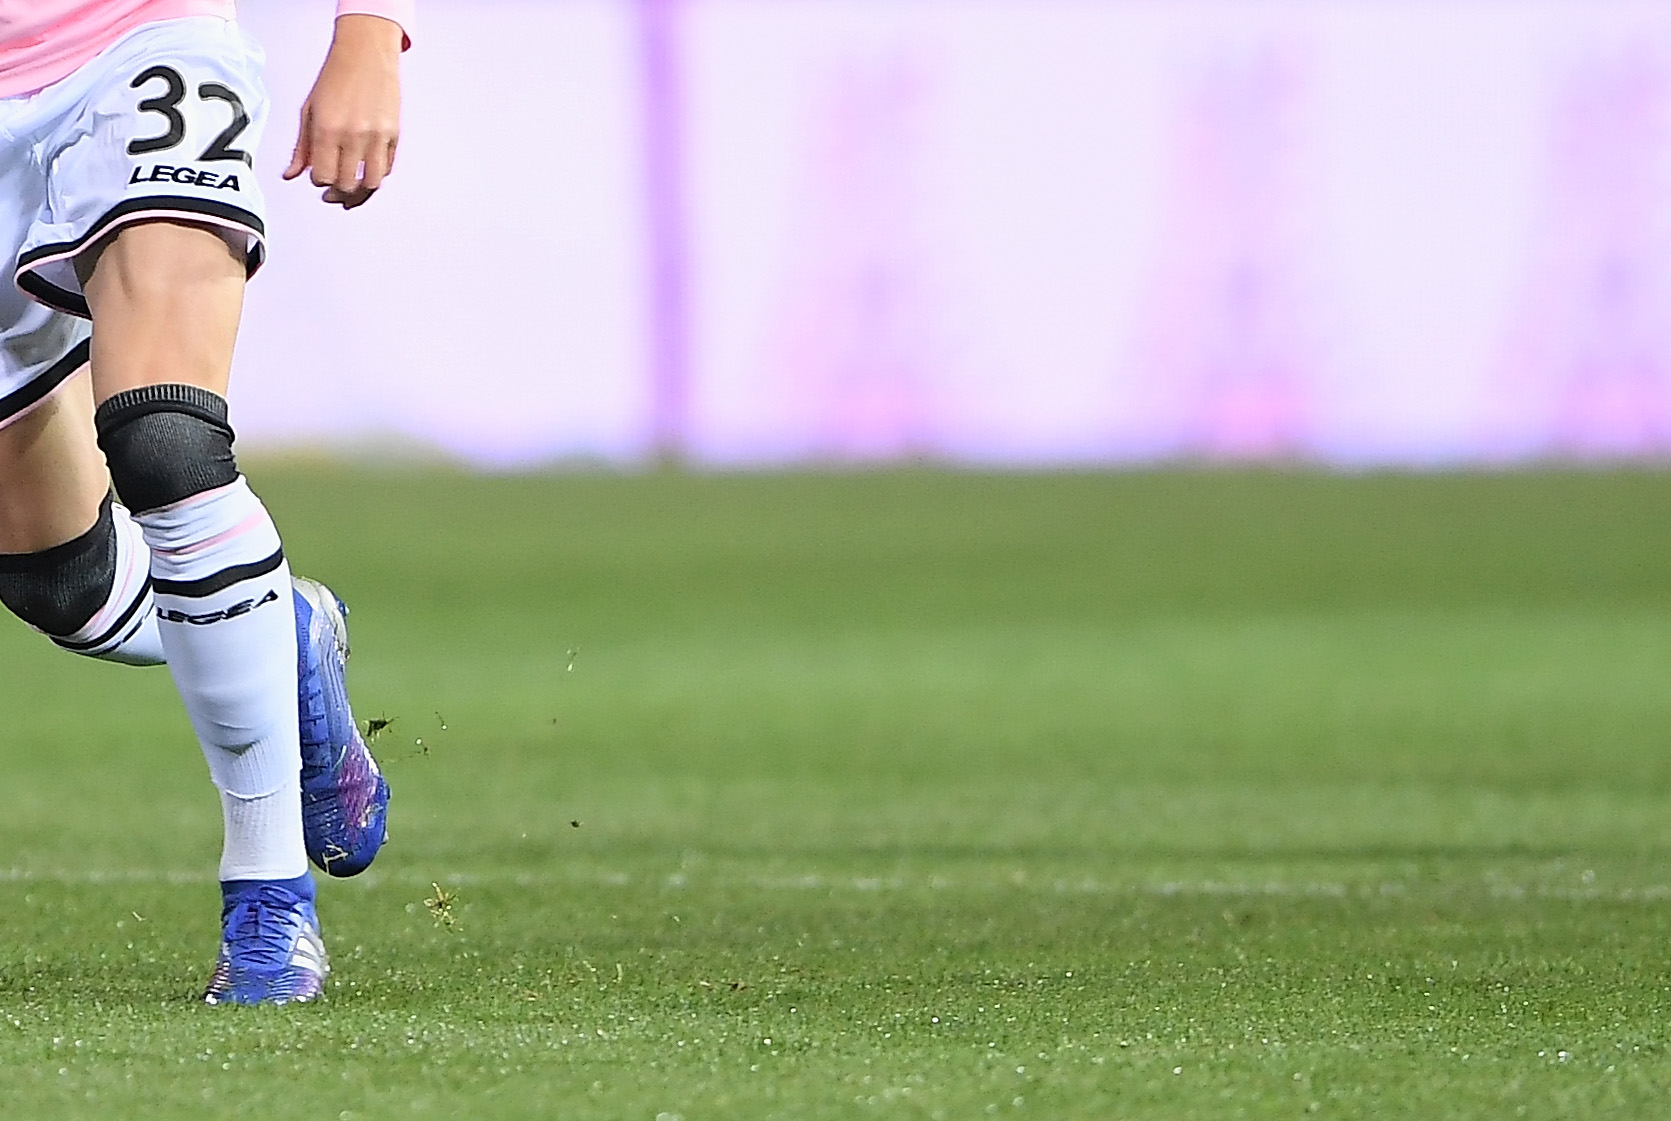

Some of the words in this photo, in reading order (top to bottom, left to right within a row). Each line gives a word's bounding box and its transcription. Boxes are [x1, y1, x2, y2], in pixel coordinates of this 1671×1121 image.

[127, 64, 253, 171] 32
[128, 164, 240, 192] LEGEA
[156, 589, 278, 626] LEGEA
